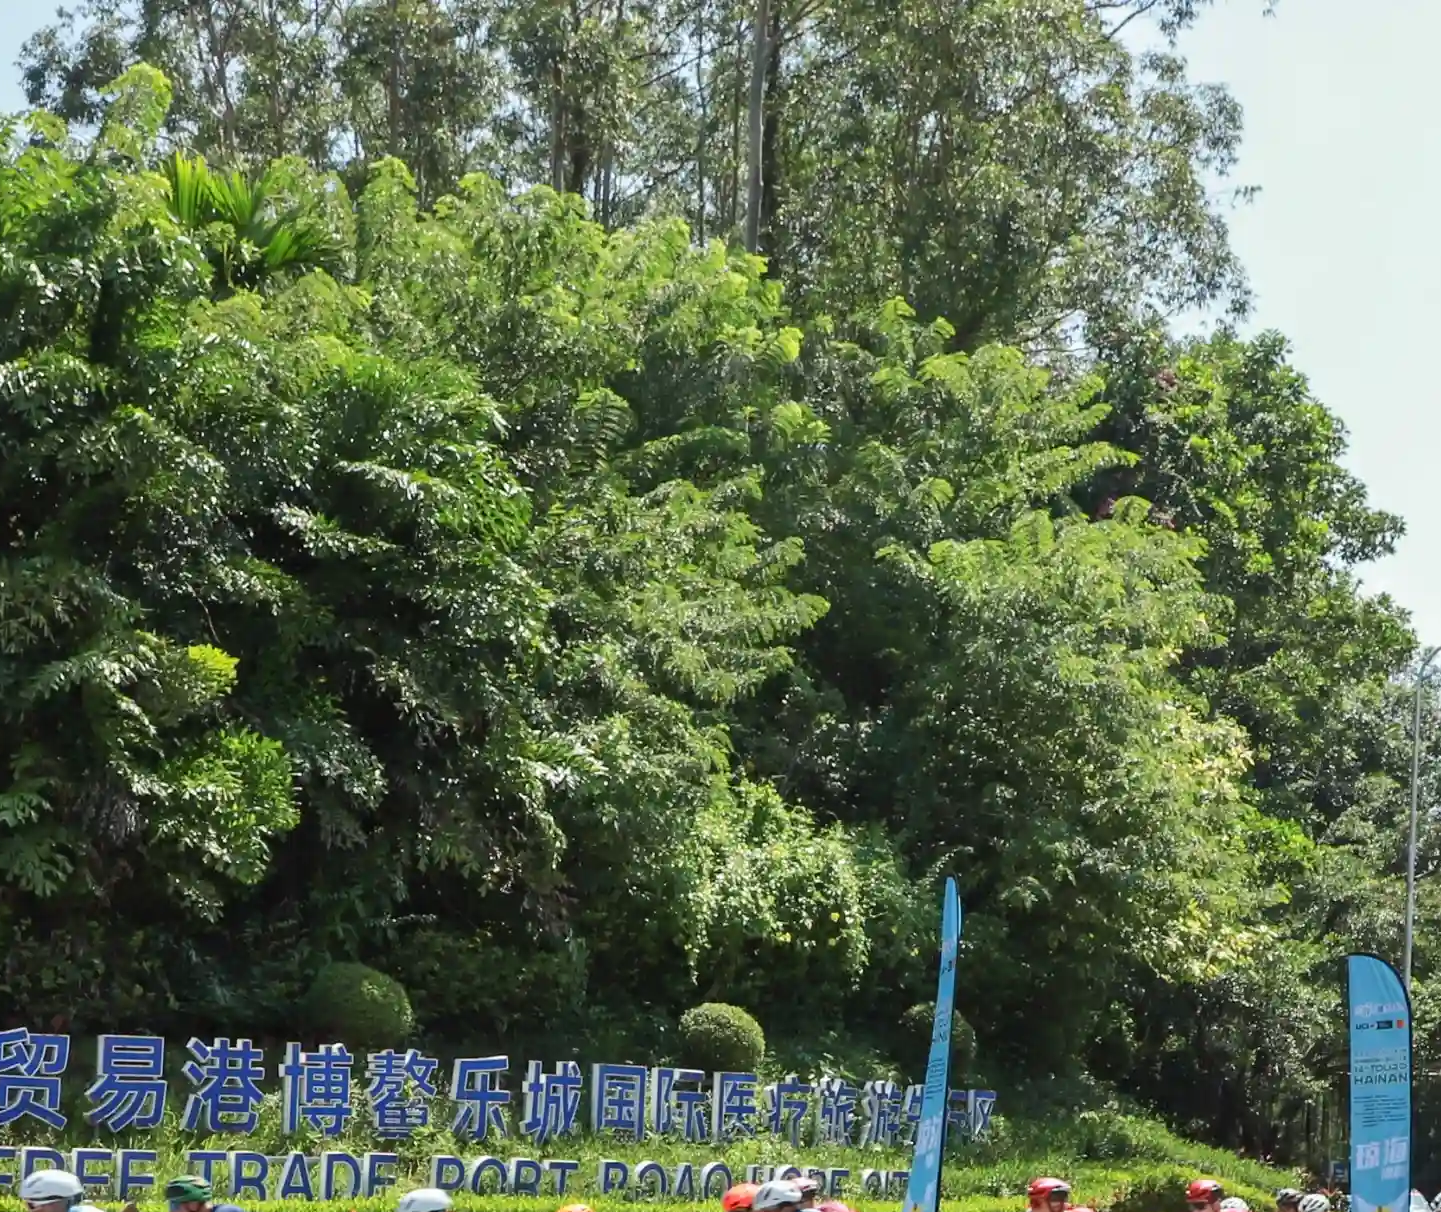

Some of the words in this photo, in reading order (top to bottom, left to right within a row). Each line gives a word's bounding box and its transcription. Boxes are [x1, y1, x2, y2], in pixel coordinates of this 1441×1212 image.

[1354, 1073, 1408, 1085] HAINAN
[187, 1147, 398, 1201] TRADE
[428, 1155, 579, 1197] PORT
